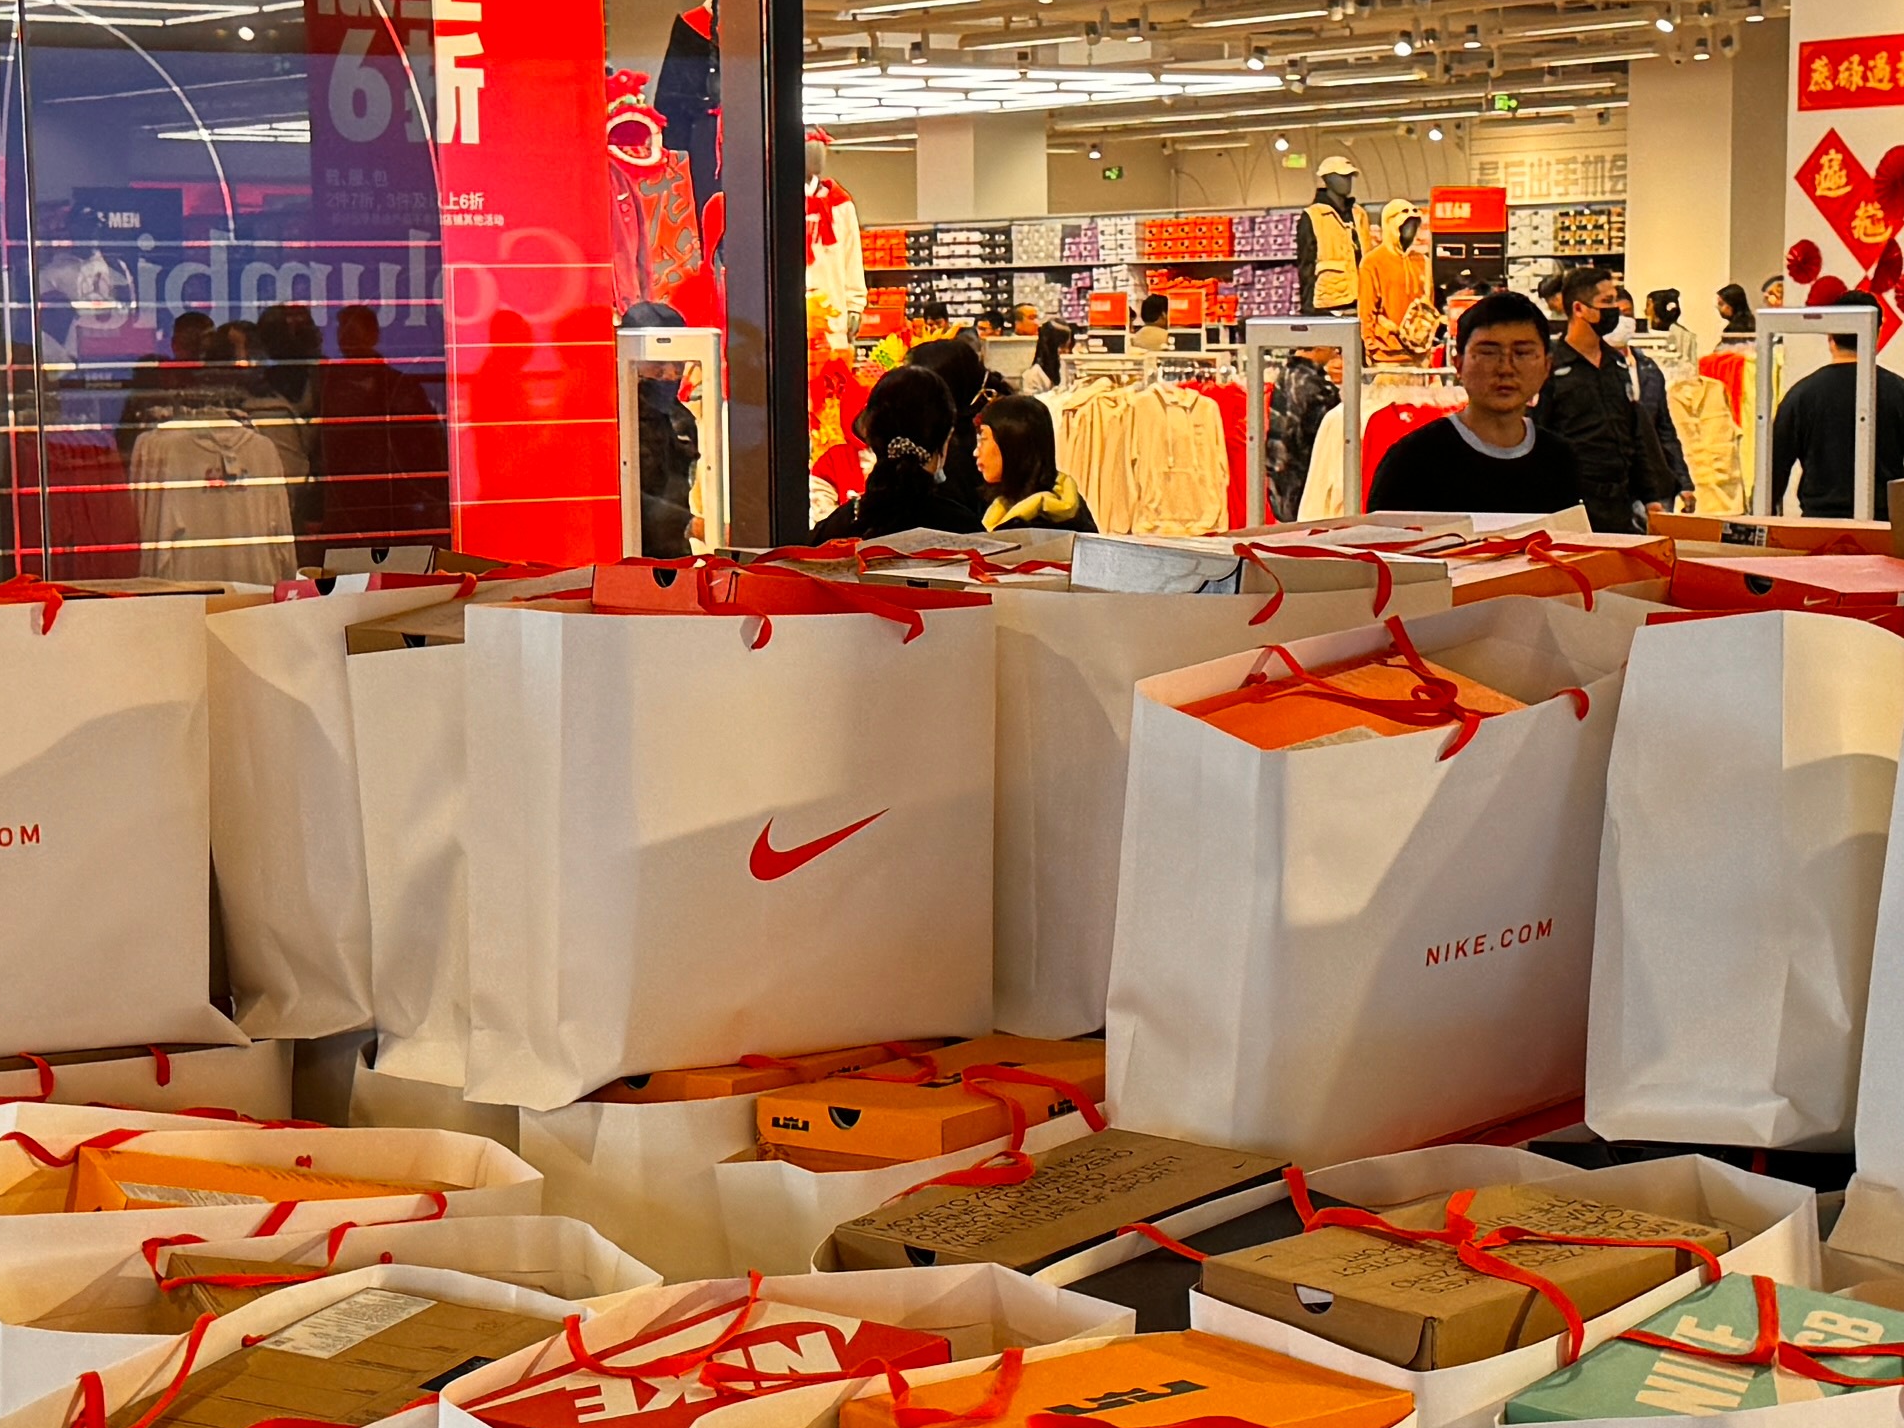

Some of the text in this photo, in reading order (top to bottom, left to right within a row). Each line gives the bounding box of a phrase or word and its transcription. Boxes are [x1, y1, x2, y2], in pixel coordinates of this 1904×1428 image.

[327, 29, 485, 145] 6折
[1424, 917, 1555, 968] NIKE.COM
[574, 1330, 849, 1424] NIKE
